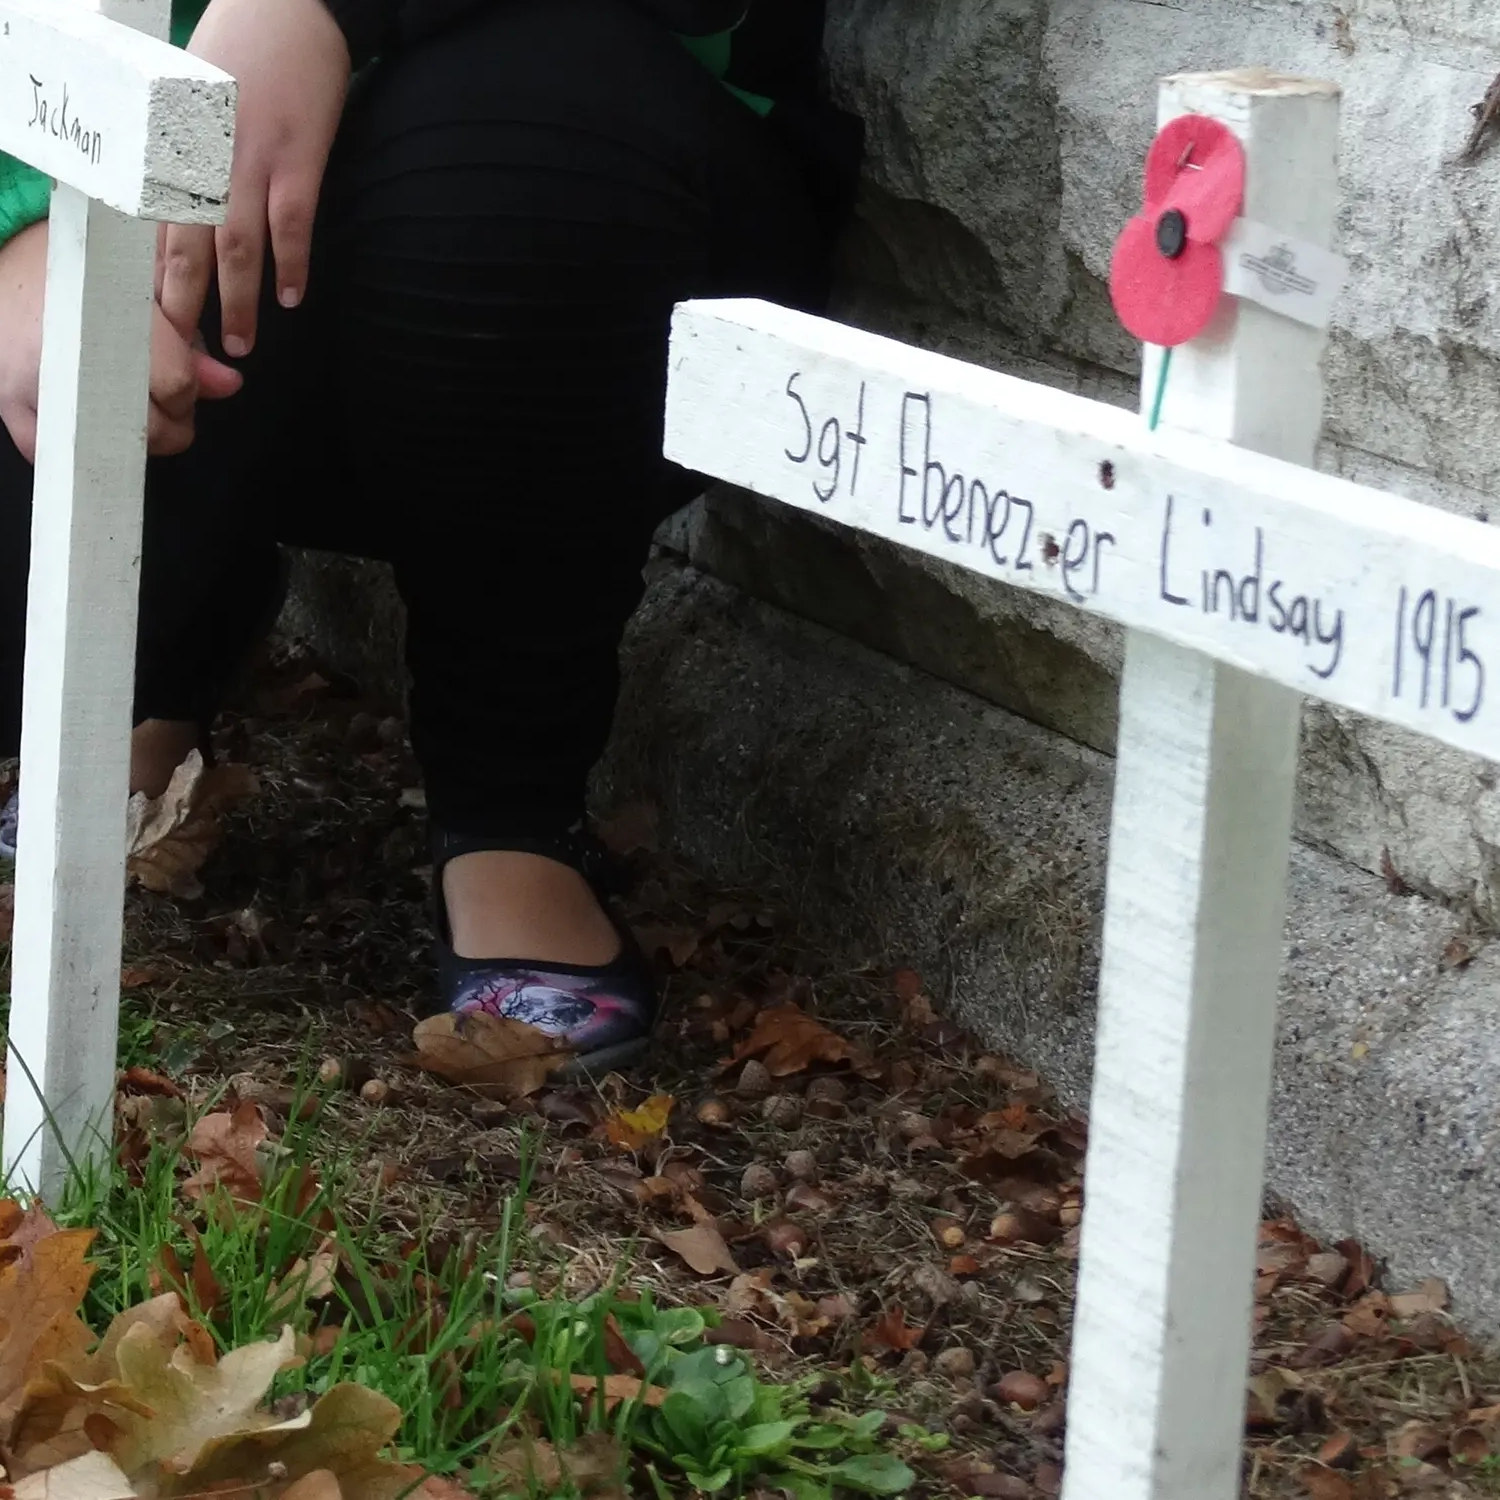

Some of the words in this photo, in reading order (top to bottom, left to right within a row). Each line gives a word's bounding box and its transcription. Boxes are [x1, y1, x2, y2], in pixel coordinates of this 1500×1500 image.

[28, 72, 101, 166] Jackman
[784, 372, 866, 502] Sgt
[899, 391, 1116, 603] Ebenezer
[1160, 493, 1345, 678] Lindsay
[1392, 585, 1484, 722] 1915
